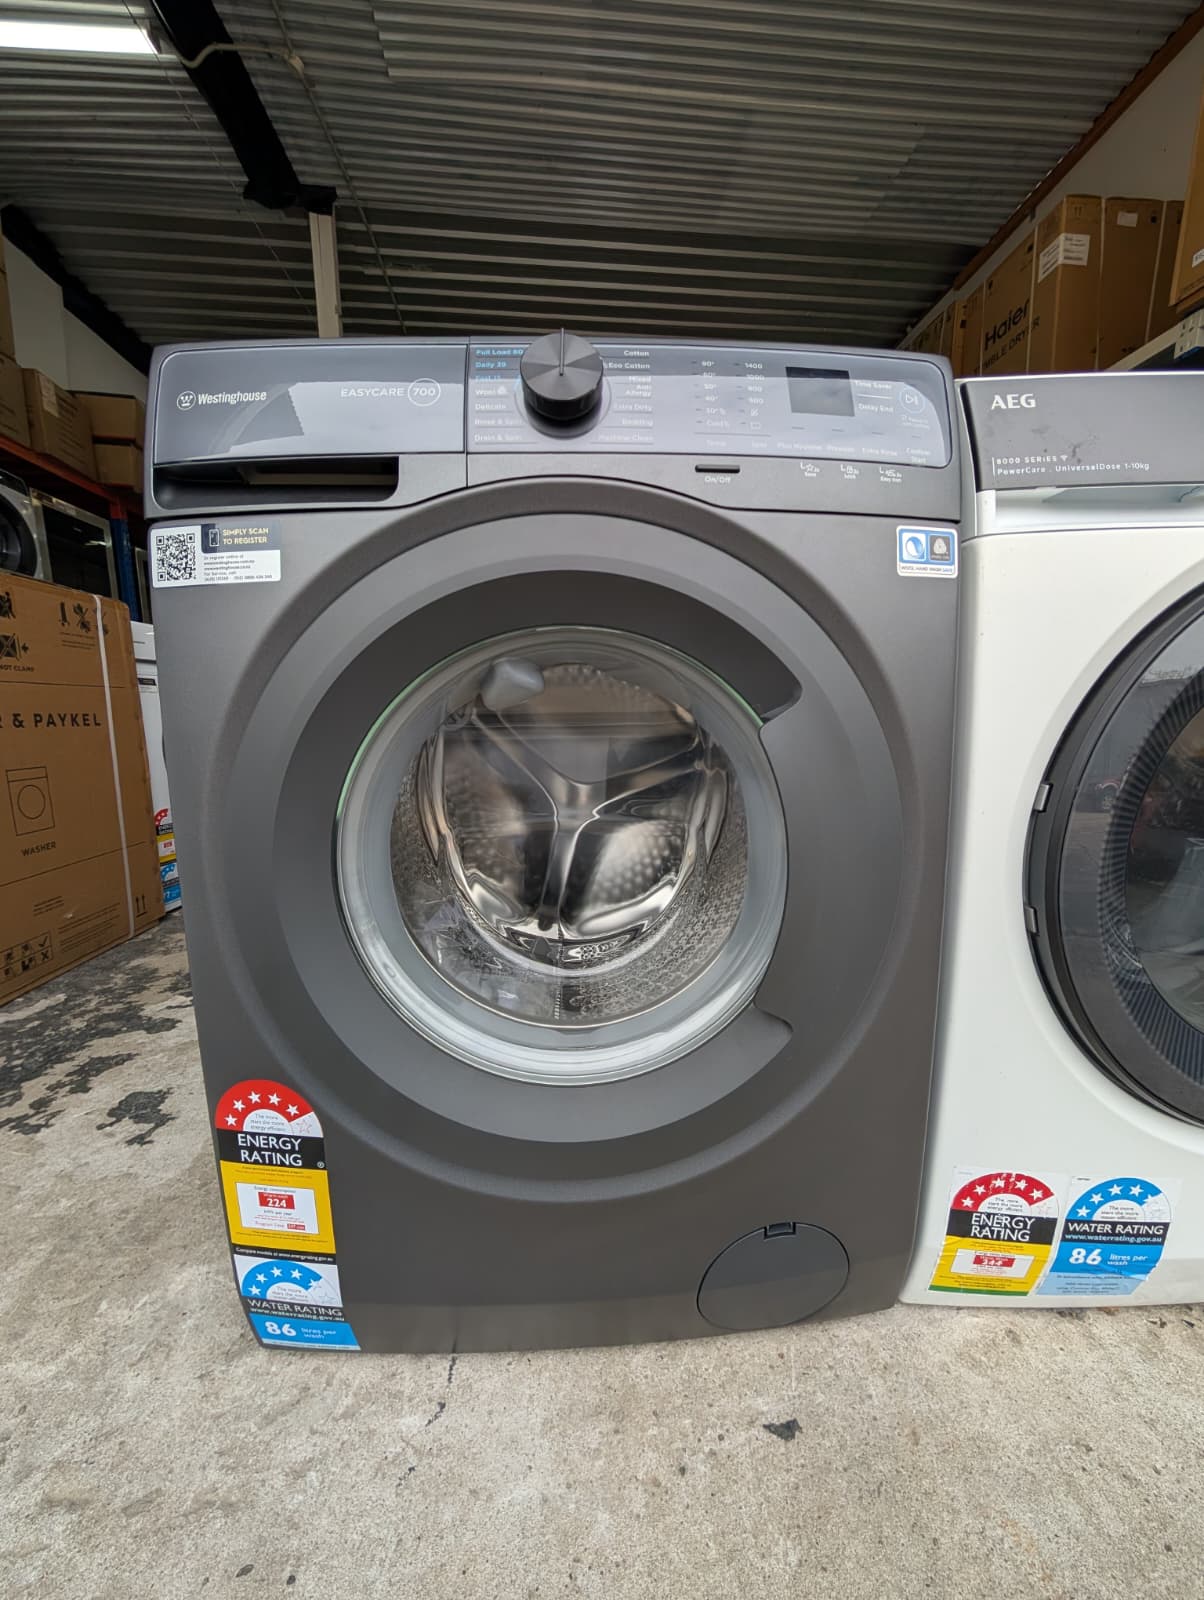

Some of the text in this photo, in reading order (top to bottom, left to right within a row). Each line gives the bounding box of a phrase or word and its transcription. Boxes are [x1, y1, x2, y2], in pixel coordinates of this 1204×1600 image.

[984, 298, 1030, 352] Haier
[623, 349, 650, 357] Cotton
[475, 361, 495, 369] Daily
[197, 390, 267, 406] Westinghouse
[340, 387, 436, 398] EASYCARE 700
[991, 393, 1036, 411] AEG
[1055, 463, 1121, 473] UniversalDose
[1124, 461, 1150, 472] 1-10kg
[704, 475, 732, 485] On/Off
[223, 527, 269, 536] SIMPLY SCAN
[234, 536, 268, 545] REGISTER
[12, 712, 25, 728] &
[33, 712, 101, 728] PAYKEL
[20, 841, 56, 857] WASHER
[237, 1133, 302, 1151] ENERGY
[240, 1149, 303, 1167] RATING
[267, 1198, 288, 1208] 224
[971, 1212, 1036, 1230] ENERGY
[1067, 1222, 1165, 1236] WATER RATING
[970, 1225, 1031, 1242] RATING
[1064, 1233, 1162, 1244] www.waterrating.gov.au
[1069, 1247, 1103, 1265] 86
[1109, 1253, 1149, 1263] litres per
[247, 1298, 343, 1317] WATER RATING
[265, 1320, 297, 1337] 86
